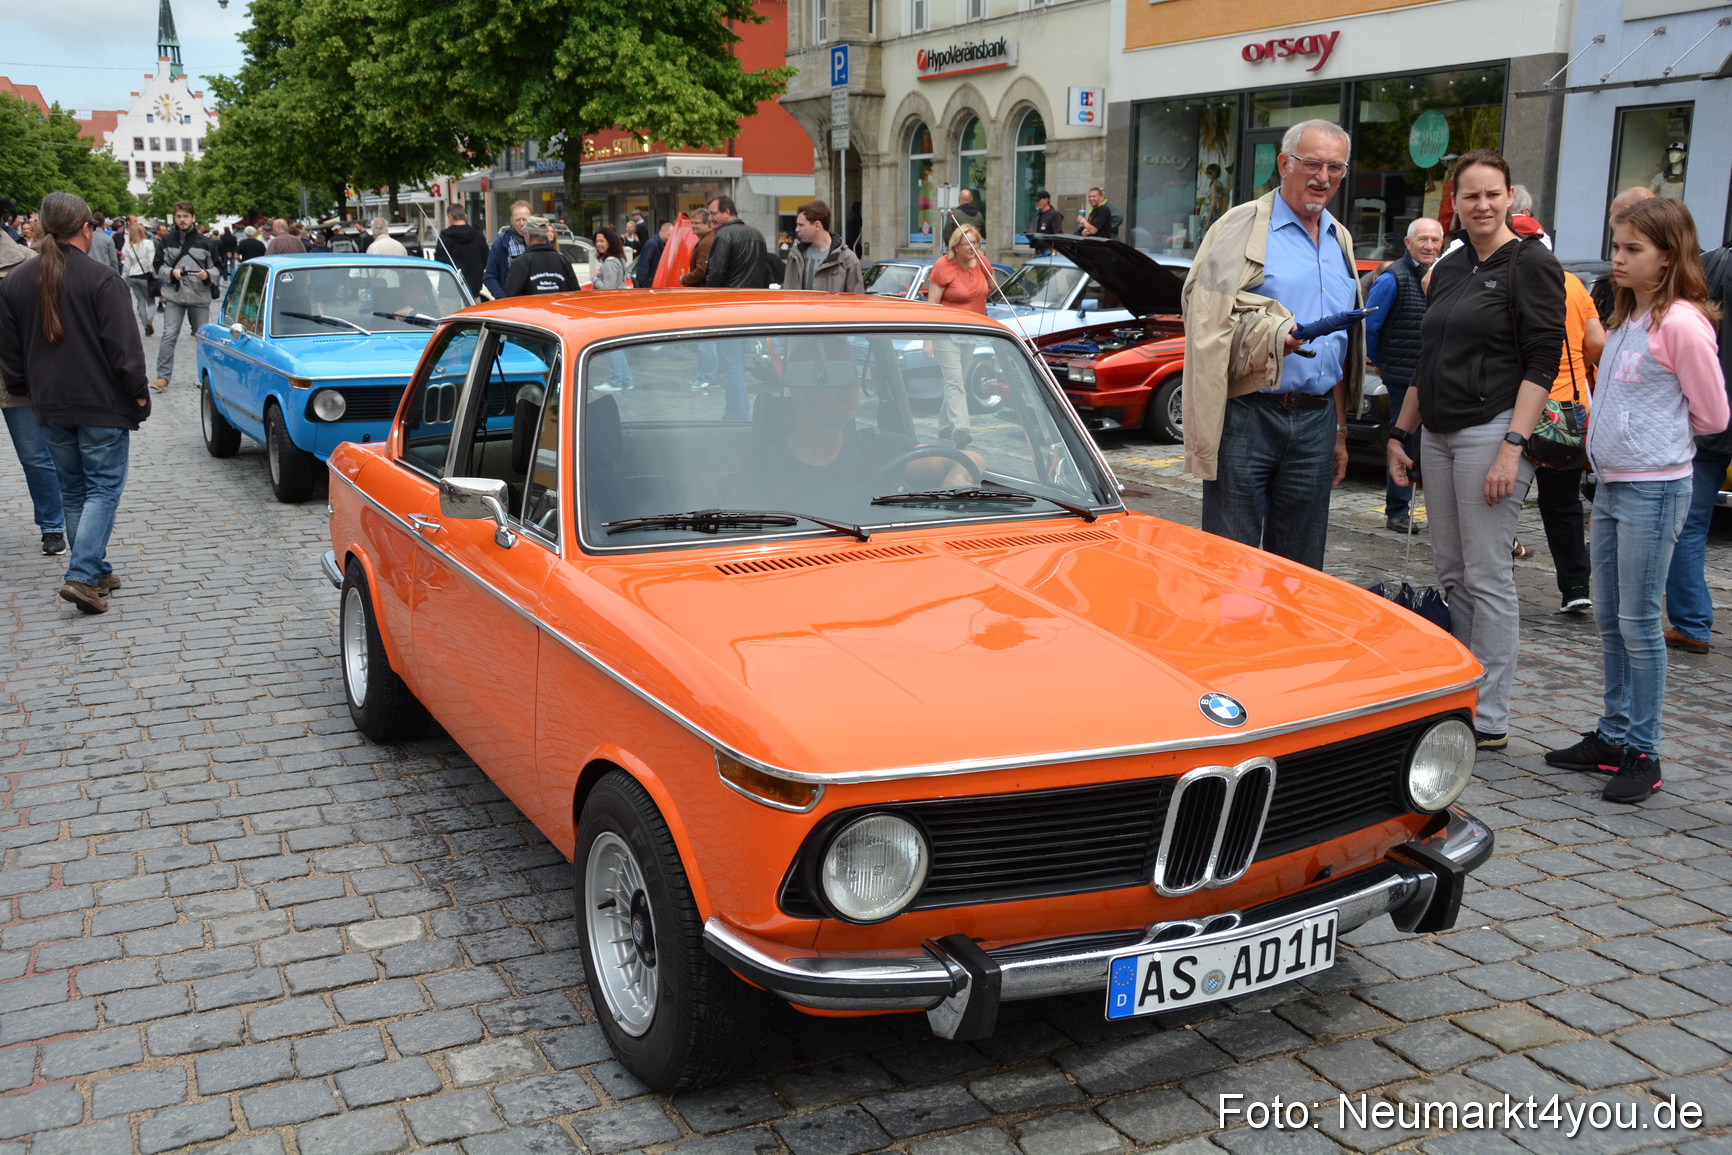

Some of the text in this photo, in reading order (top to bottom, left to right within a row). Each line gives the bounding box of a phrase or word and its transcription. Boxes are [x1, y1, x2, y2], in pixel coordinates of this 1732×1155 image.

[834, 51, 845, 81] P
[927, 36, 1007, 72] HypoVereinsbank
[1241, 30, 1341, 72] orsay
[1080, 91, 1093, 107] EC
[1143, 154, 1191, 172] orsay
[1613, 350, 1643, 384] M
[1117, 993, 1127, 1007] D
[1138, 955, 1198, 1007] AS
[1228, 919, 1334, 990] AD1H
